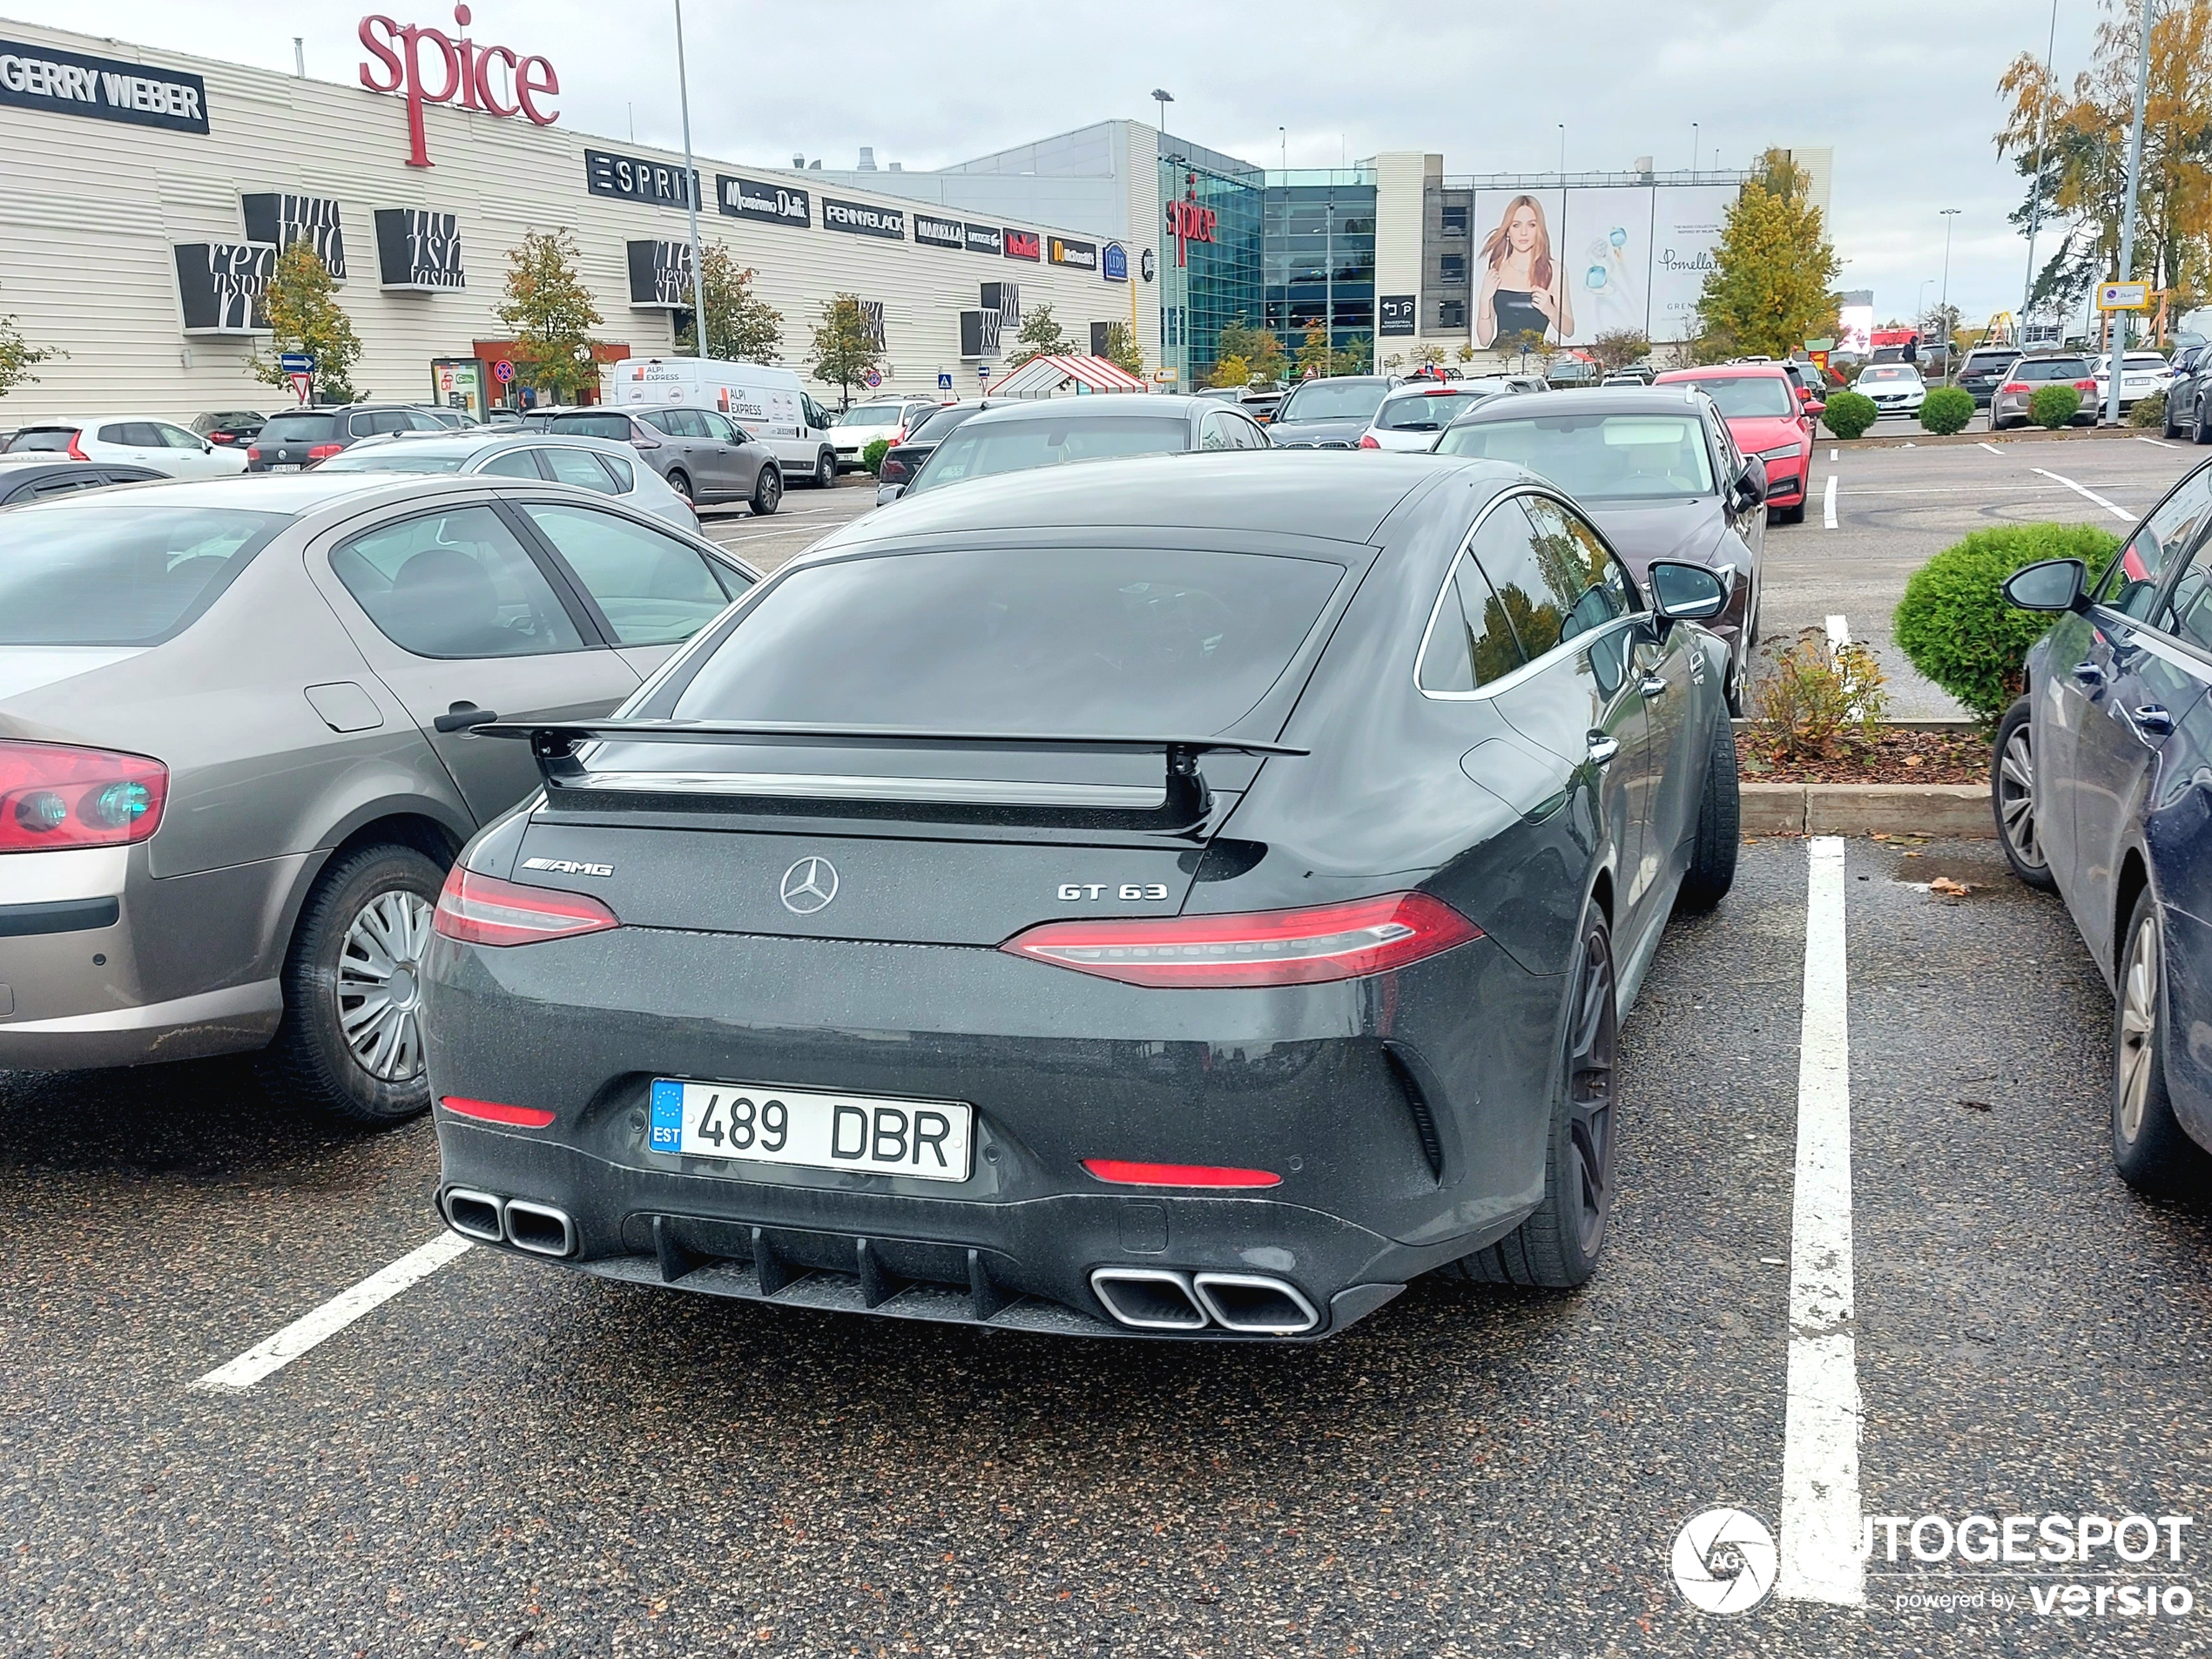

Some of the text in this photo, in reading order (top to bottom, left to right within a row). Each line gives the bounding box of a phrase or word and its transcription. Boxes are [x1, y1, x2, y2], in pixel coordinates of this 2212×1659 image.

[0, 54, 203, 120] GERRY WEBER
[358, 3, 560, 167] spice
[726, 180, 807, 219] Massimo Dutti
[826, 205, 904, 233] PENNYBLACK
[1166, 172, 1217, 267] spice
[918, 219, 965, 243] MARELLA
[968, 231, 991, 245] LACOSTE
[1109, 254, 1125, 270] LIDO
[1657, 248, 1723, 271] Pomella
[1403, 306, 1412, 316] P
[730, 388, 746, 401] ALPI
[731, 402, 762, 415] EXPRESS
[548, 860, 614, 878] AMG
[1057, 883, 1169, 901] GT 63
[652, 1126, 681, 1144] EST
[698, 1094, 948, 1168] 489 DBR
